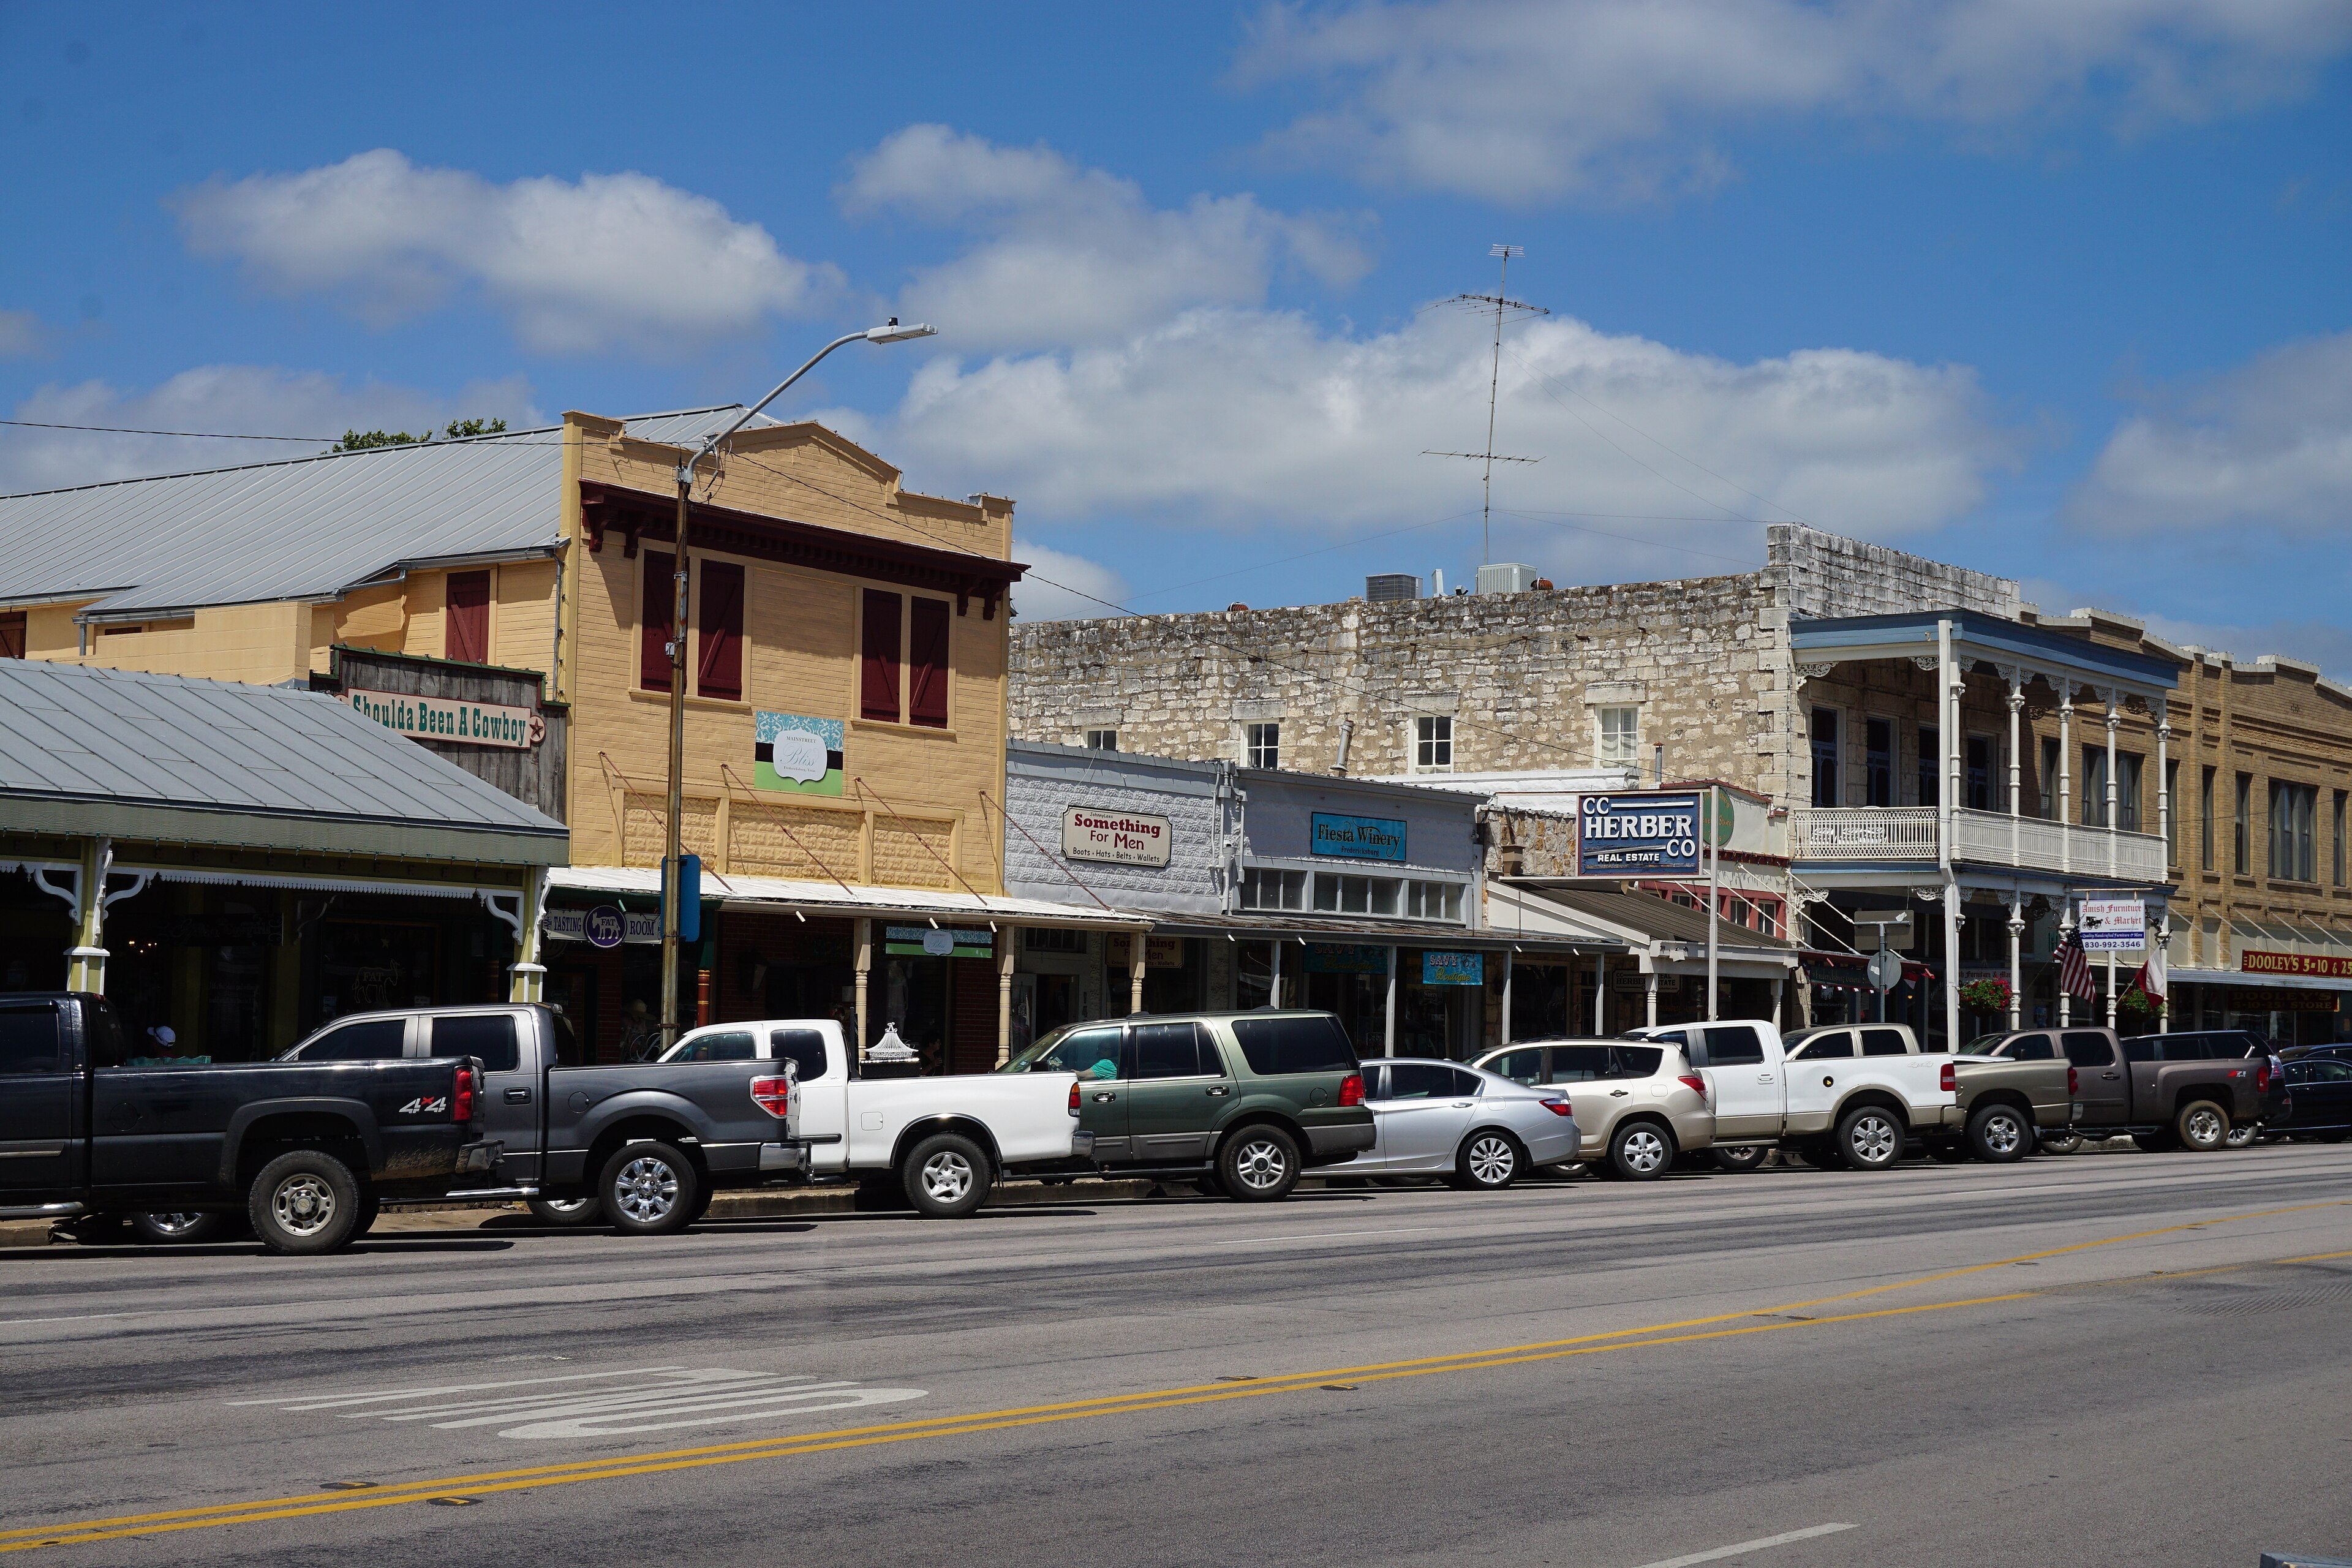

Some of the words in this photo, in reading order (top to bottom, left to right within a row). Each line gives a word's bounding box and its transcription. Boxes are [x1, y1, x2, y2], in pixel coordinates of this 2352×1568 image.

[418, 702, 454, 734] Been
[459, 706, 468, 736] A
[473, 707, 526, 746] Cowboy
[780, 742, 819, 767] Bliss
[1583, 796, 1610, 815] CC
[1074, 813, 1161, 839] Something
[1585, 815, 1694, 839] HERBER
[1719, 815, 1732, 826] Store
[1090, 830, 1109, 842] For
[1114, 832, 1144, 850] Men
[1317, 822, 1355, 843] Fiesta
[1354, 820, 1401, 858] Winery
[1072, 846, 1090, 856] Boots
[1096, 849, 1110, 858] Hats
[1116, 851, 1131, 860] Belts
[1137, 853, 1159, 862] Wallets
[1341, 845, 1379, 857] Fredericksburg
[1666, 839, 1695, 857] CO
[1597, 854, 1623, 863] REAL
[1626, 853, 1660, 862] ESTATE
[2082, 904, 2105, 913] Amish
[2106, 904, 2142, 914] Furniture
[553, 916, 581, 932] TASTING
[629, 920, 655, 936] ROOM
[2105, 916, 2111, 925] &
[2113, 916, 2142, 925] Market
[1114, 938, 1175, 950] Sothing
[1324, 956, 1376, 971] Boutique
[1430, 954, 1458, 967] SAVY
[2248, 955, 2299, 971] DOOLEY'S
[2302, 958, 2328, 973] 5-10
[2332, 962, 2337, 976] &
[2341, 960, 2352, 975] 25
[363, 972, 383, 981] FAT
[1436, 968, 1471, 983] Boutique
[2233, 991, 2332, 1001] DOOLEY'S
